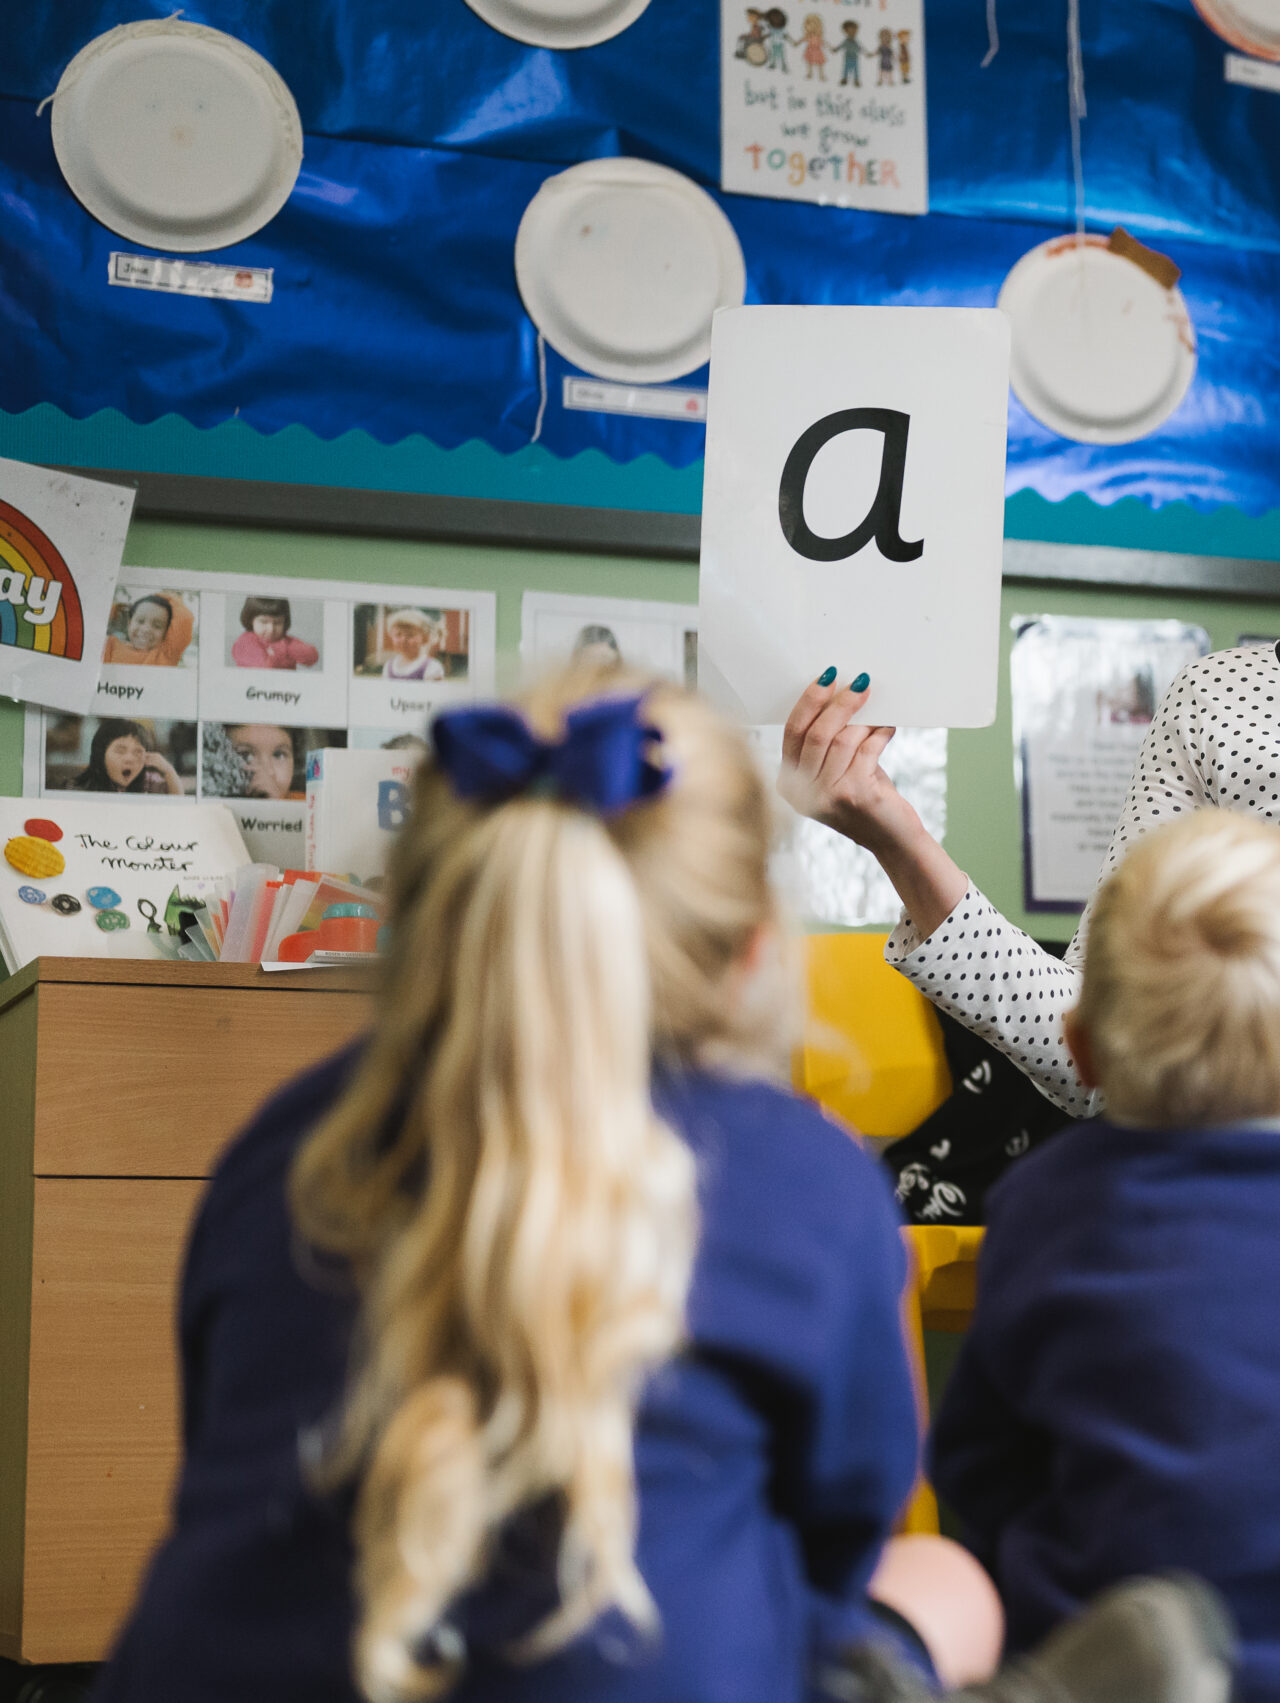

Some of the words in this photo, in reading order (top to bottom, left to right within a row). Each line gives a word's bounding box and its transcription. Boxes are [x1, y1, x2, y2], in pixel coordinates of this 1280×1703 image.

[744, 79, 778, 110] but
[787, 86, 807, 110] in
[816, 92, 852, 121] this
[861, 97, 904, 127] class
[782, 122, 809, 139] we
[819, 125, 869, 153] grow
[779, 407, 924, 562] a
[97, 681, 144, 699] Happy
[246, 687, 301, 704] Grumpy
[390, 698, 432, 713] Upset
[240, 818, 303, 832] Worried
[75, 834, 118, 851] The
[126, 836, 199, 851] Colour
